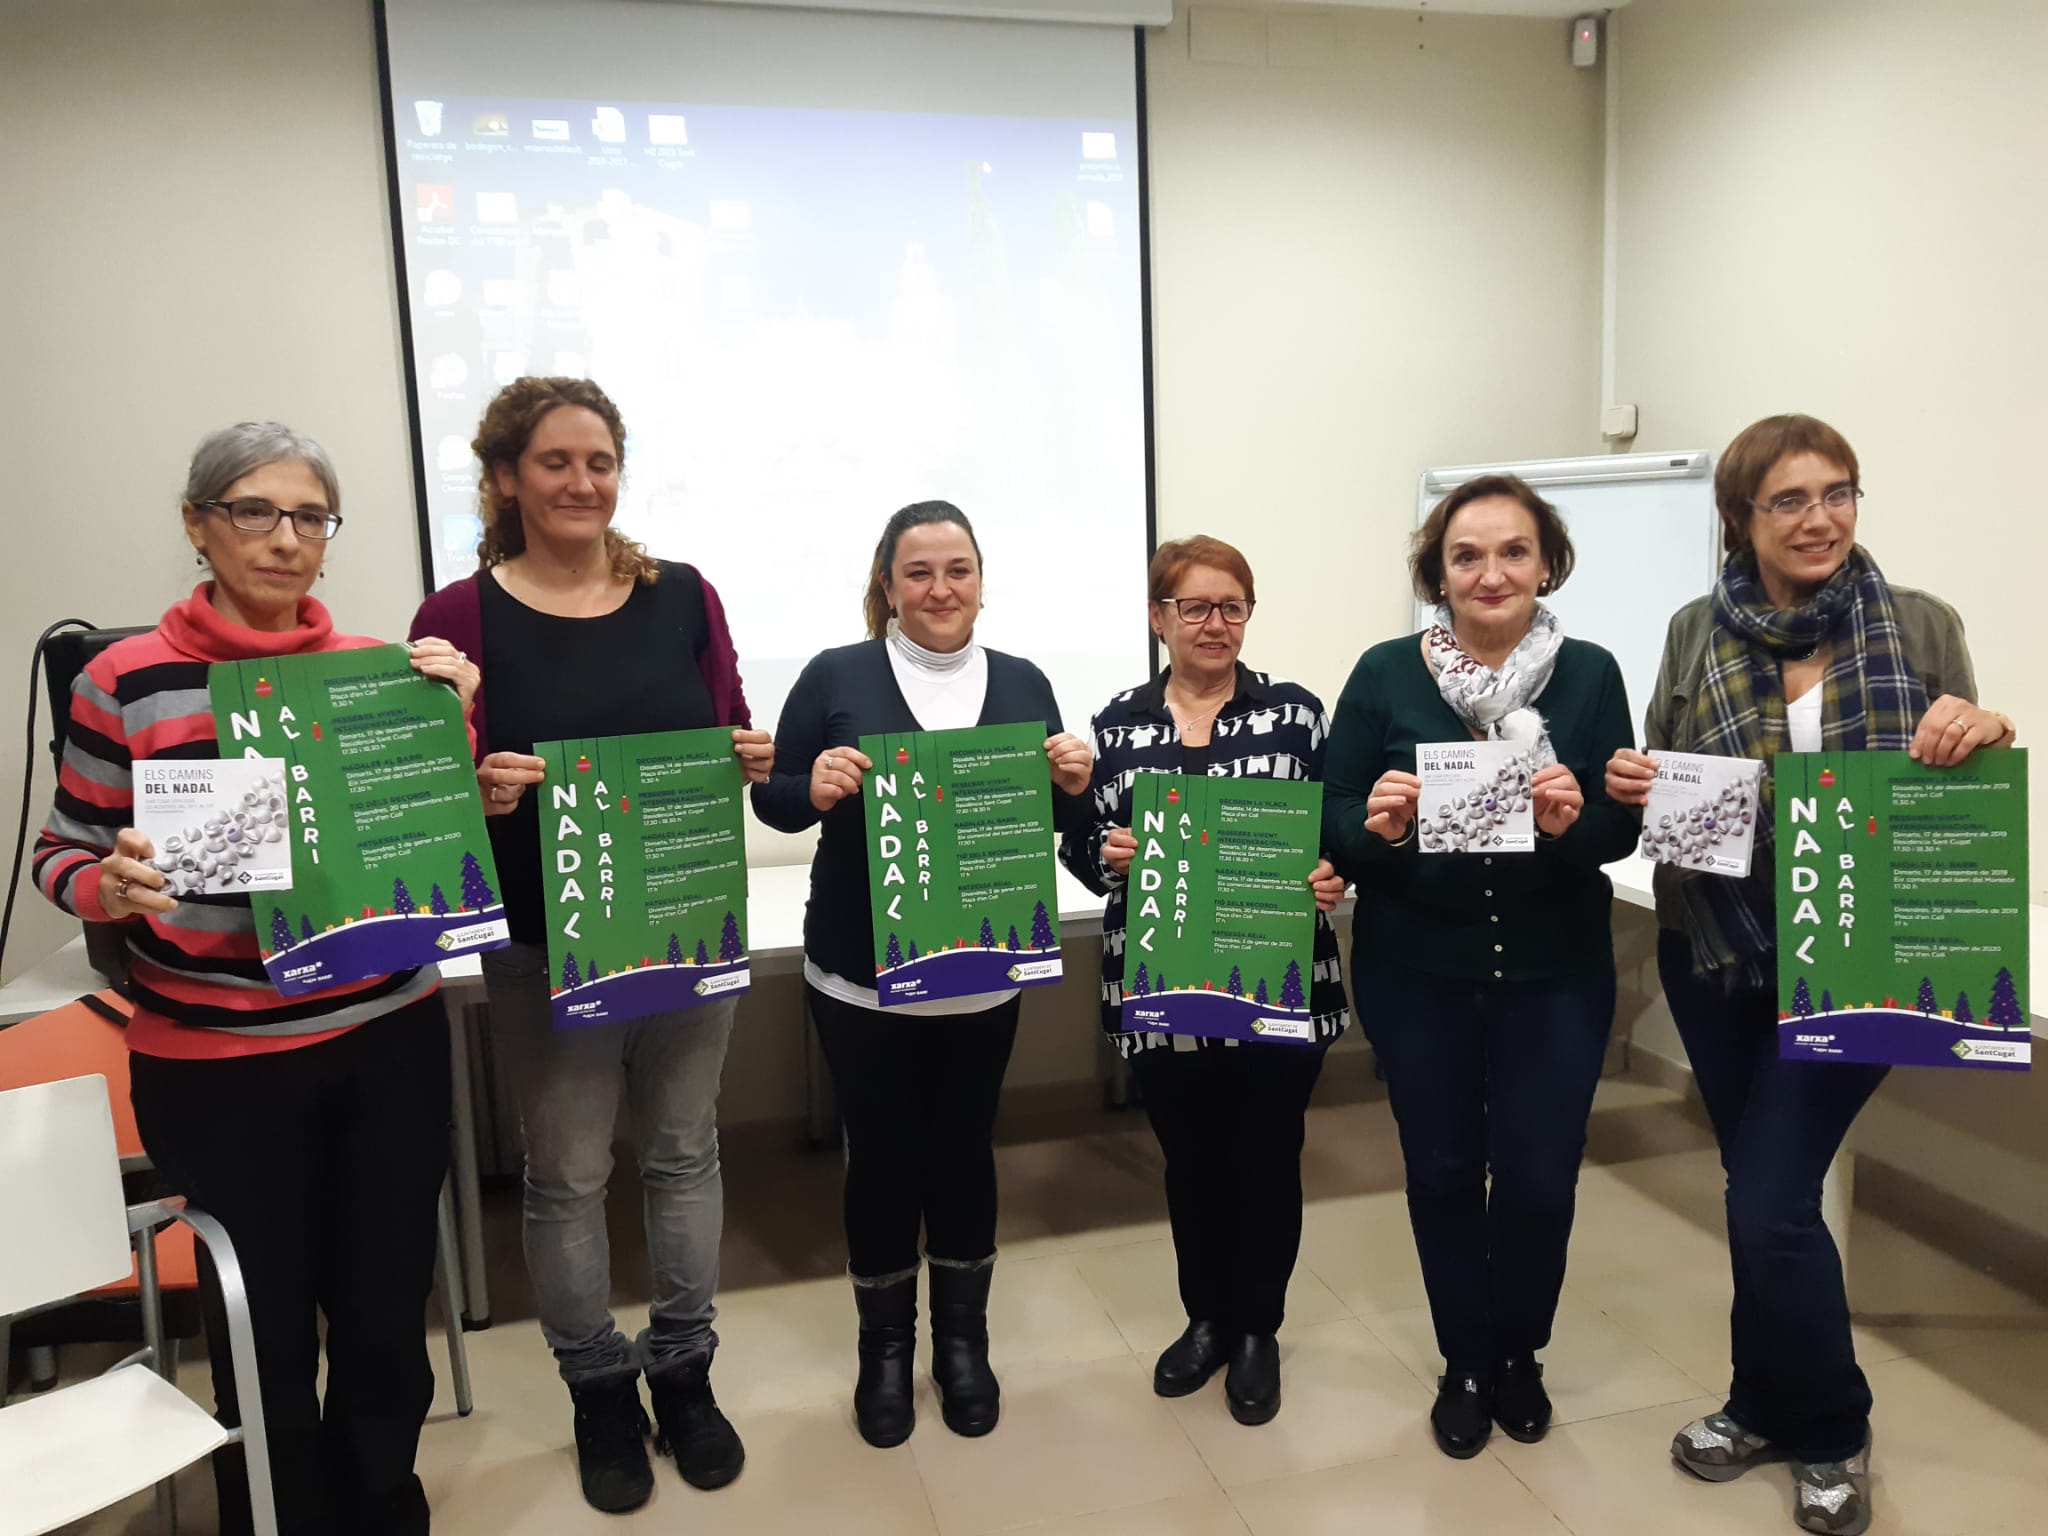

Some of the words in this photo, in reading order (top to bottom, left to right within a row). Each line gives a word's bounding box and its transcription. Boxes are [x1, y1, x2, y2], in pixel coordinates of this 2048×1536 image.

[1424, 750, 1438, 760] ELS
[1441, 749, 1475, 759] CAMINS
[1425, 762, 1441, 770] DEL
[1444, 761, 1475, 770] NADAL
[1672, 761, 1704, 773] CAMINS
[145, 769, 165, 780] ELS
[169, 769, 214, 780] CAMINS
[145, 784, 168, 794] DEL
[173, 783, 214, 794] NADAL
[279, 706, 300, 739] AL
[291, 765, 318, 864] BARRI
[912, 772, 926, 799] AL
[1654, 771, 1669, 780] DEL
[1672, 772, 1702, 784] NADAL
[594, 780, 610, 810] AL
[1178, 813, 1192, 840] AL
[1836, 797, 1855, 830] AL
[552, 783, 585, 939] NADAL
[875, 774, 905, 920] NADAL
[916, 820, 931, 901] BARRI
[598, 833, 614, 918] BARRI
[1140, 810, 1165, 952] NADAL
[1790, 797, 1822, 964] NADAL
[1174, 860, 1190, 938] BARRI
[1838, 854, 1855, 948] BARRI
